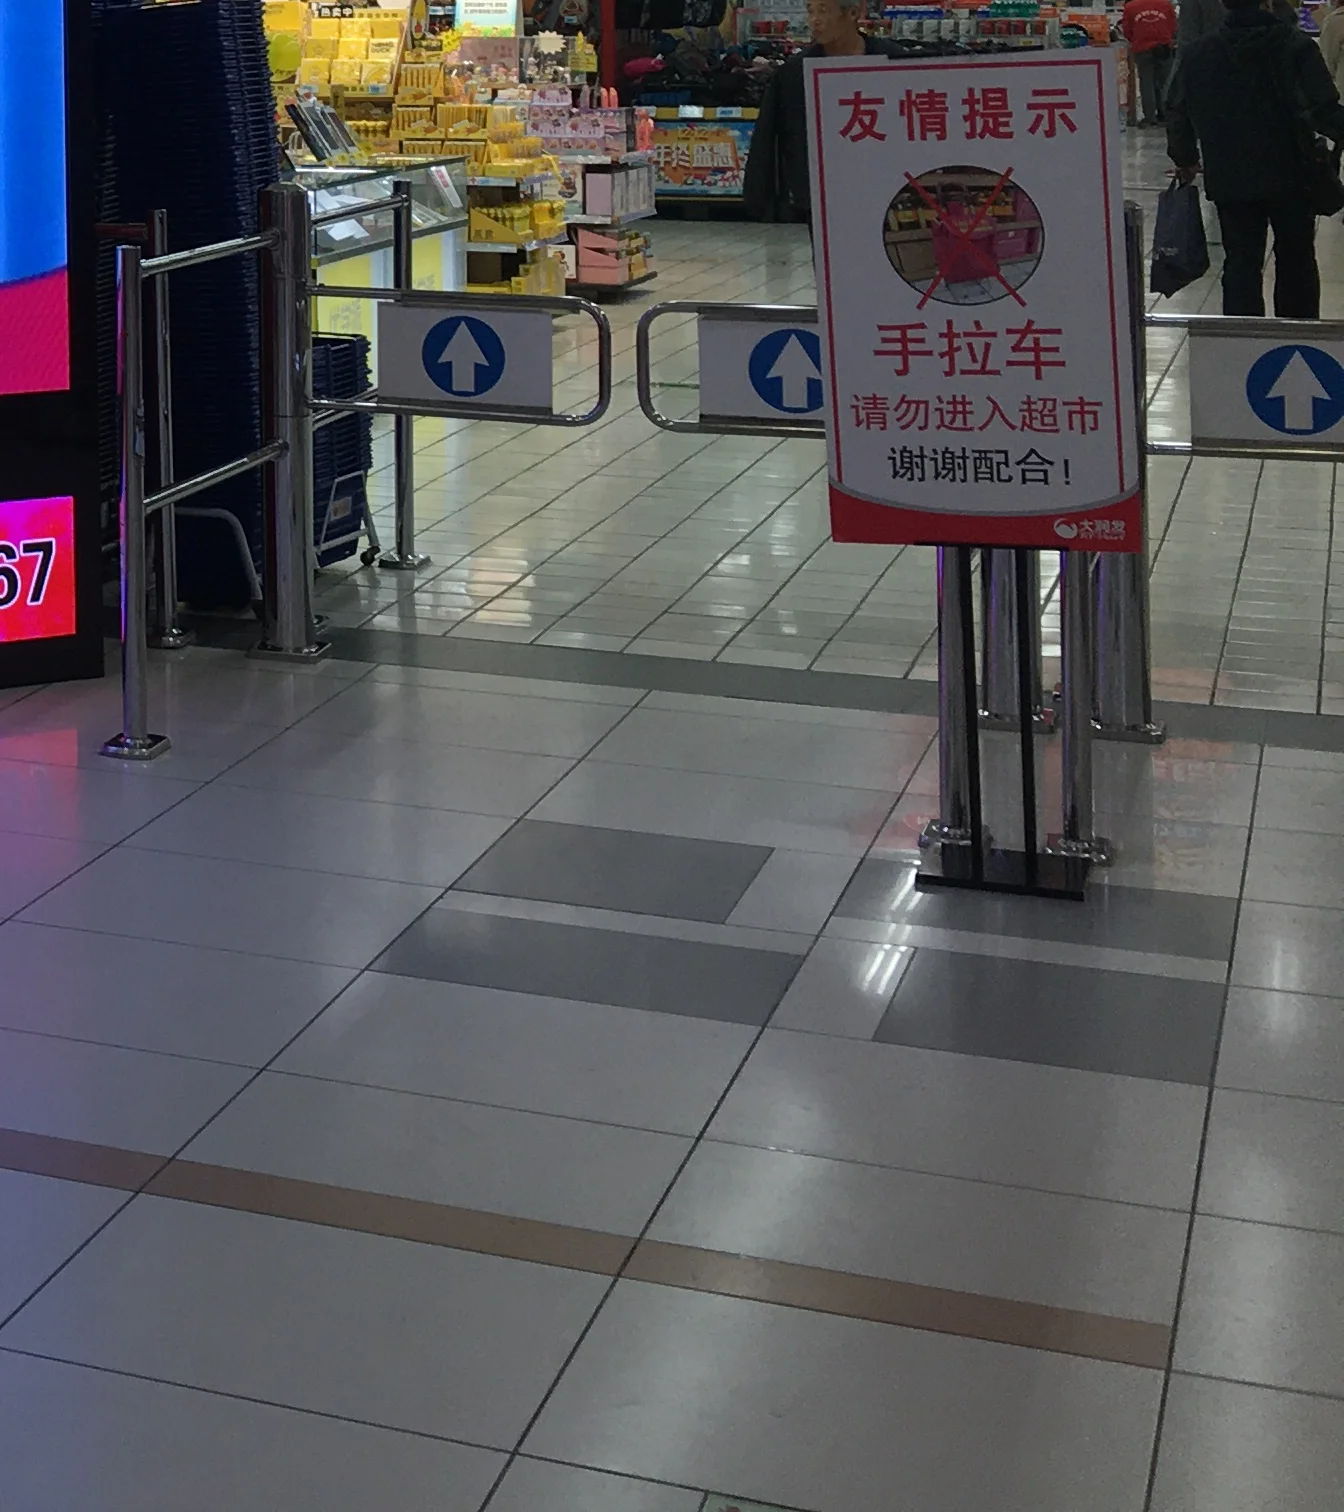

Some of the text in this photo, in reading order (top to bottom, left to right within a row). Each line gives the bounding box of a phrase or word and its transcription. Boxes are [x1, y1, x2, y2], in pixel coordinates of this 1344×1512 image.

[837, 88, 1079, 143] 友情提示
[873, 319, 1068, 381] 手拉车
[851, 395, 1103, 436] 请勿进入超市
[888, 446, 1071, 487] 谢谢配合!
